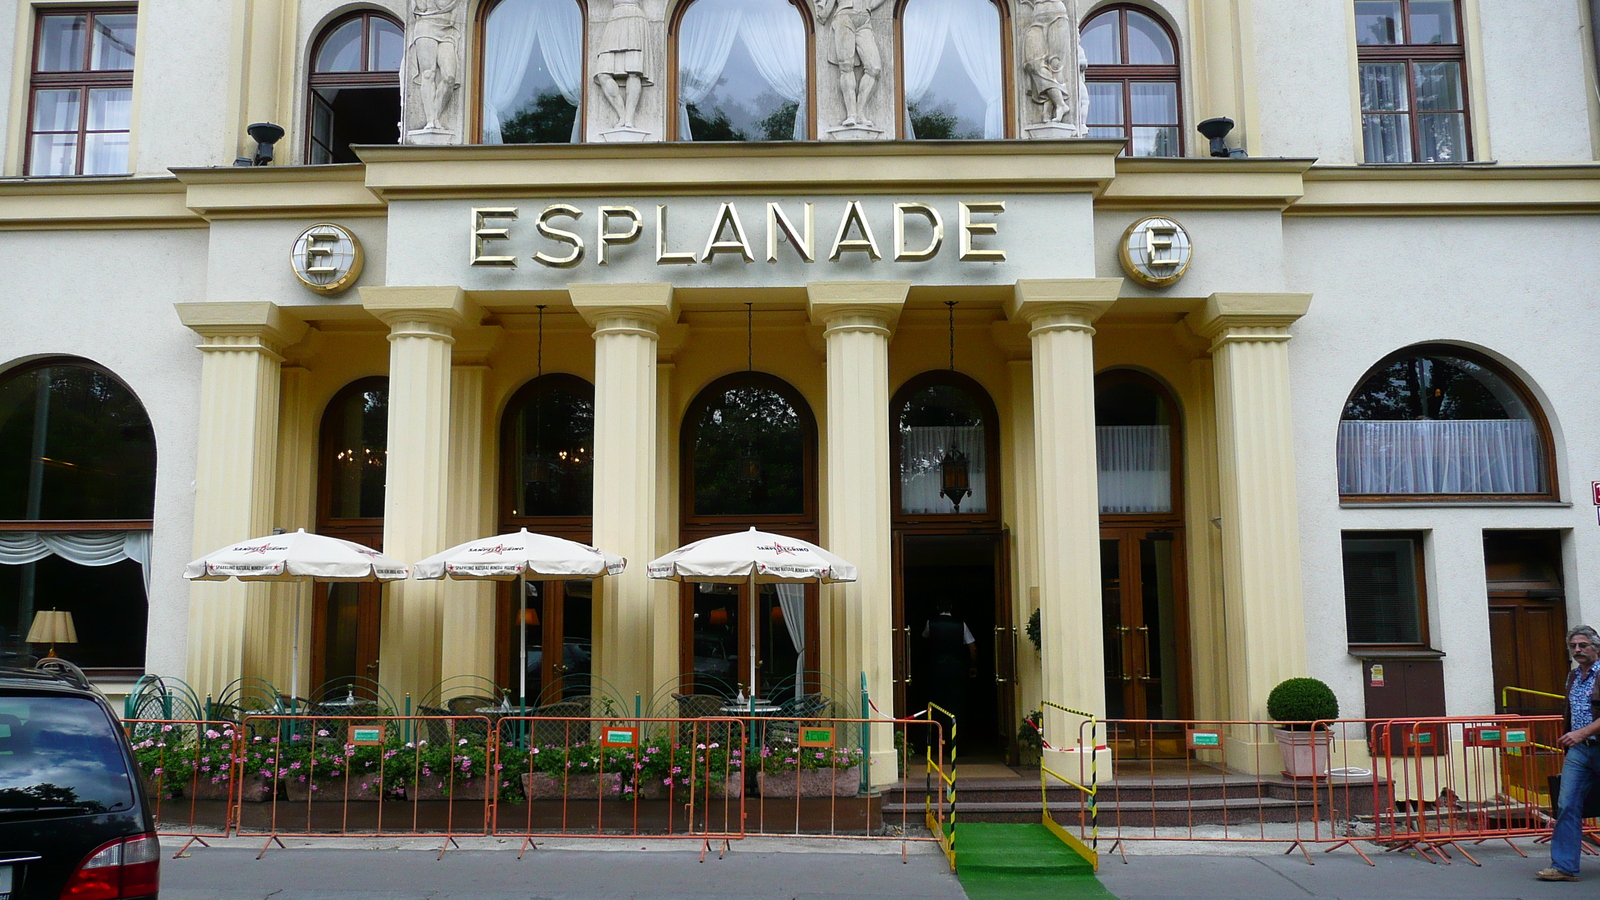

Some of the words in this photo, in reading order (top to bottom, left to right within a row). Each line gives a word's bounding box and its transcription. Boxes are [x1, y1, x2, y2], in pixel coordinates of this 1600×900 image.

[306, 233, 339, 275] E
[470, 201, 1007, 269] ESPLANADE
[1145, 227, 1180, 267] E
